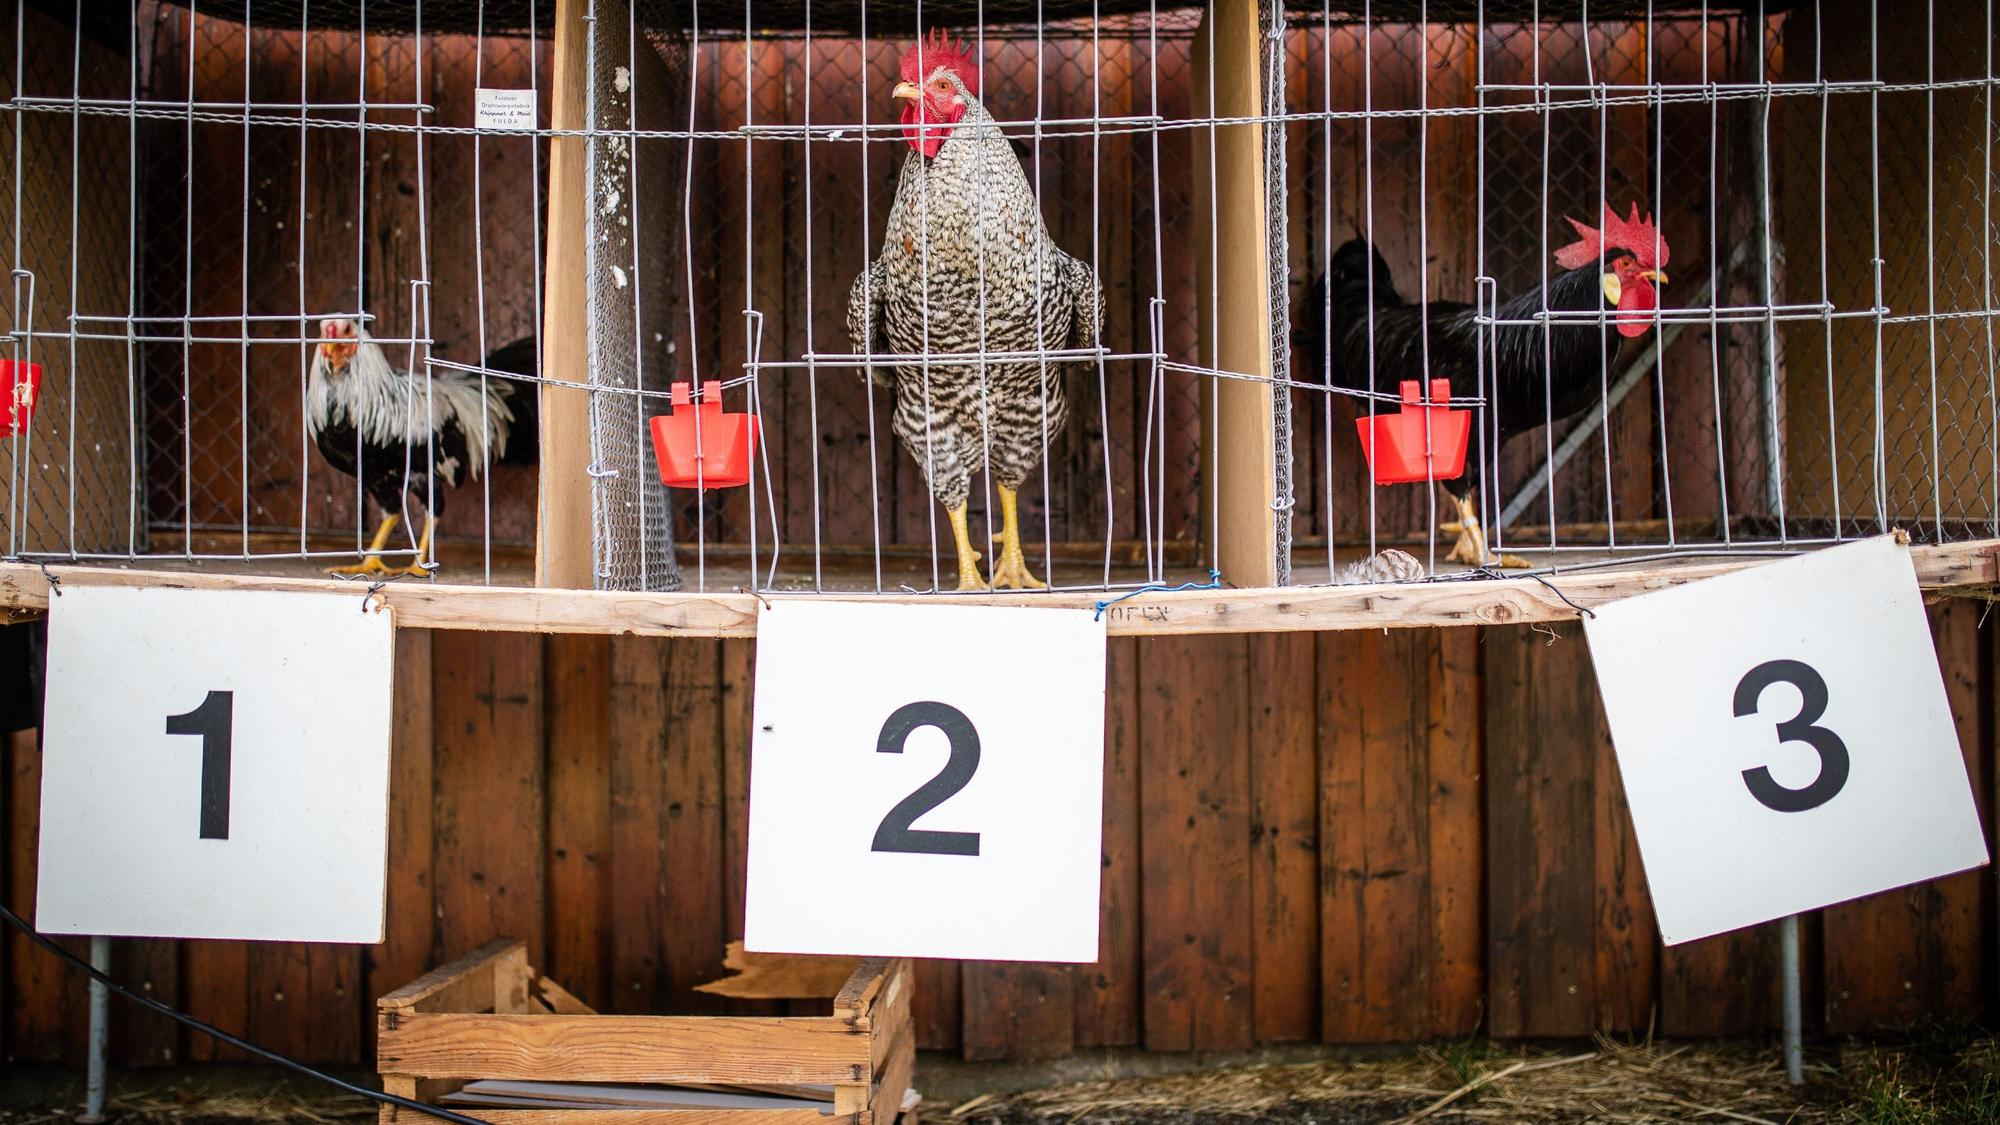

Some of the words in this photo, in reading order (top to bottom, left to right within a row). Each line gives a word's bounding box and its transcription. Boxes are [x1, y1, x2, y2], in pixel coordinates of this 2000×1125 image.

[166, 691, 233, 840] 1
[871, 701, 981, 856] 2
[1733, 660, 1849, 812] 3
